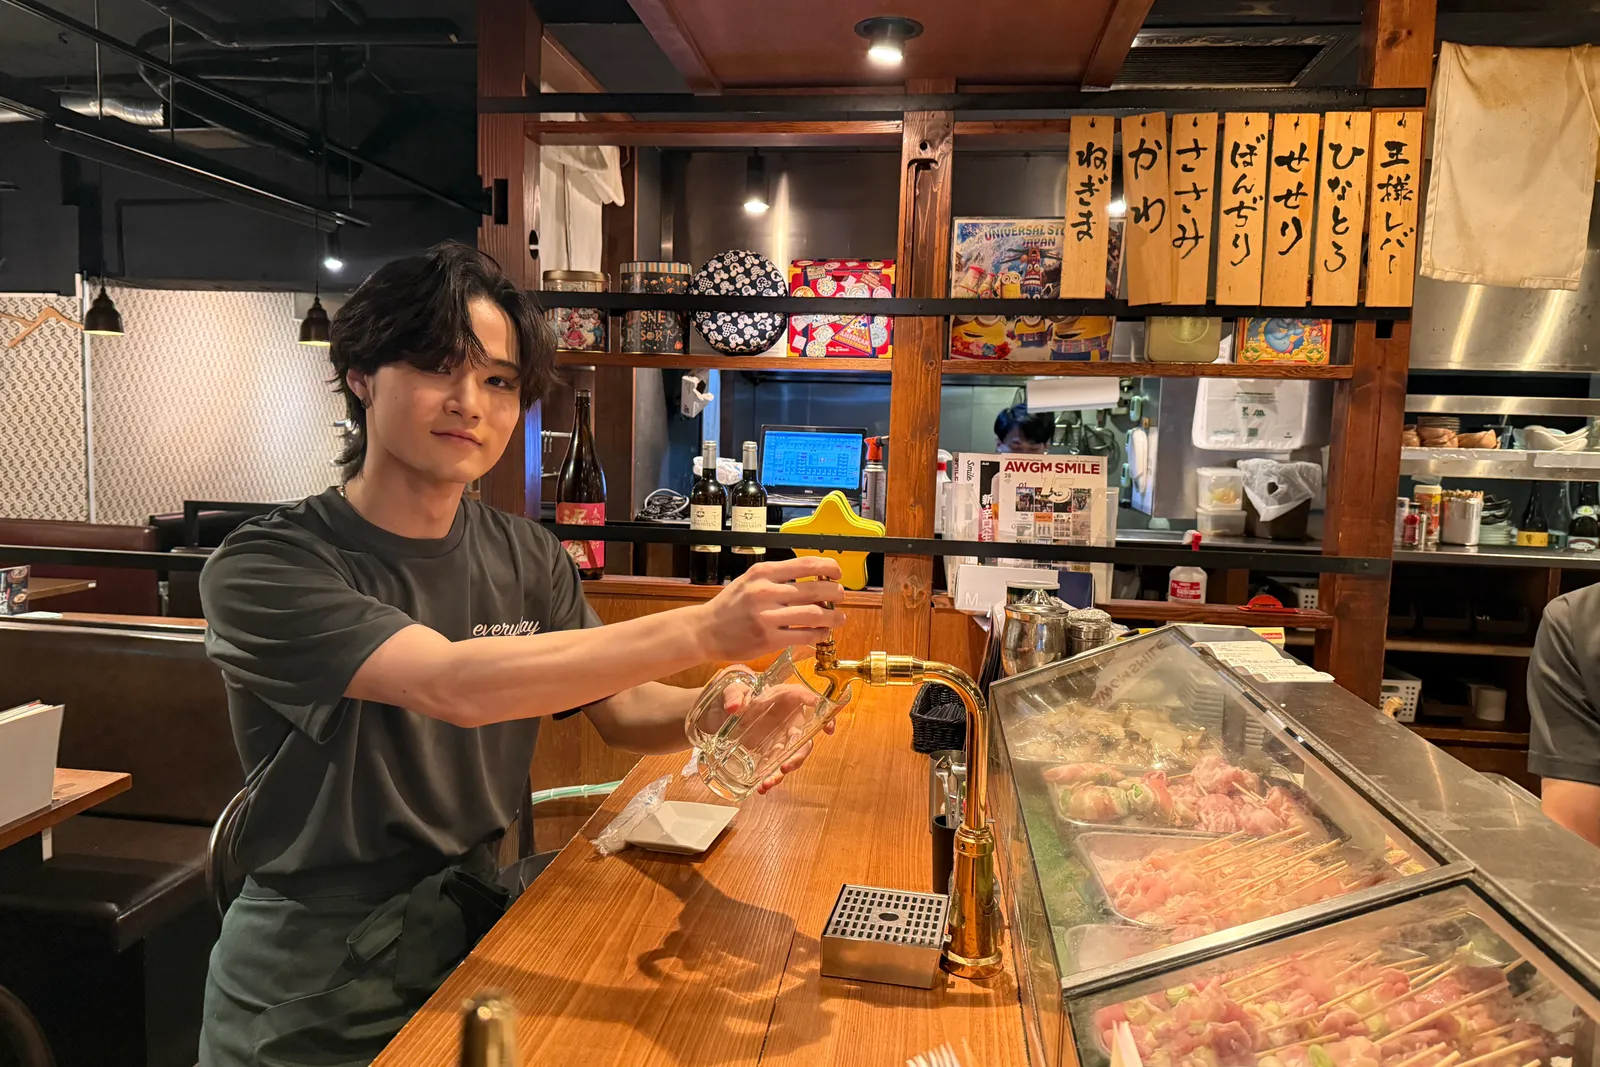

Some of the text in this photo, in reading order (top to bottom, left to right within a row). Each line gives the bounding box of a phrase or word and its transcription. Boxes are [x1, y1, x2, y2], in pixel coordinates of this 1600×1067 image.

[984, 224, 1046, 241] UNIVERSAL
[1071, 141, 1108, 243] ねぎま
[1128, 138, 1167, 235] かわ
[1172, 138, 1208, 260] ささみ
[1274, 142, 1308, 256] せせり
[1324, 142, 1364, 273] ひなとろ
[1377, 141, 1415, 275] 王様レバー
[1022, 237, 1056, 247] JAPAN
[840, 331, 870, 346] AMERICAN
[967, 460, 975, 482] Smile
[1004, 461, 1100, 475] AWGM SMILE
